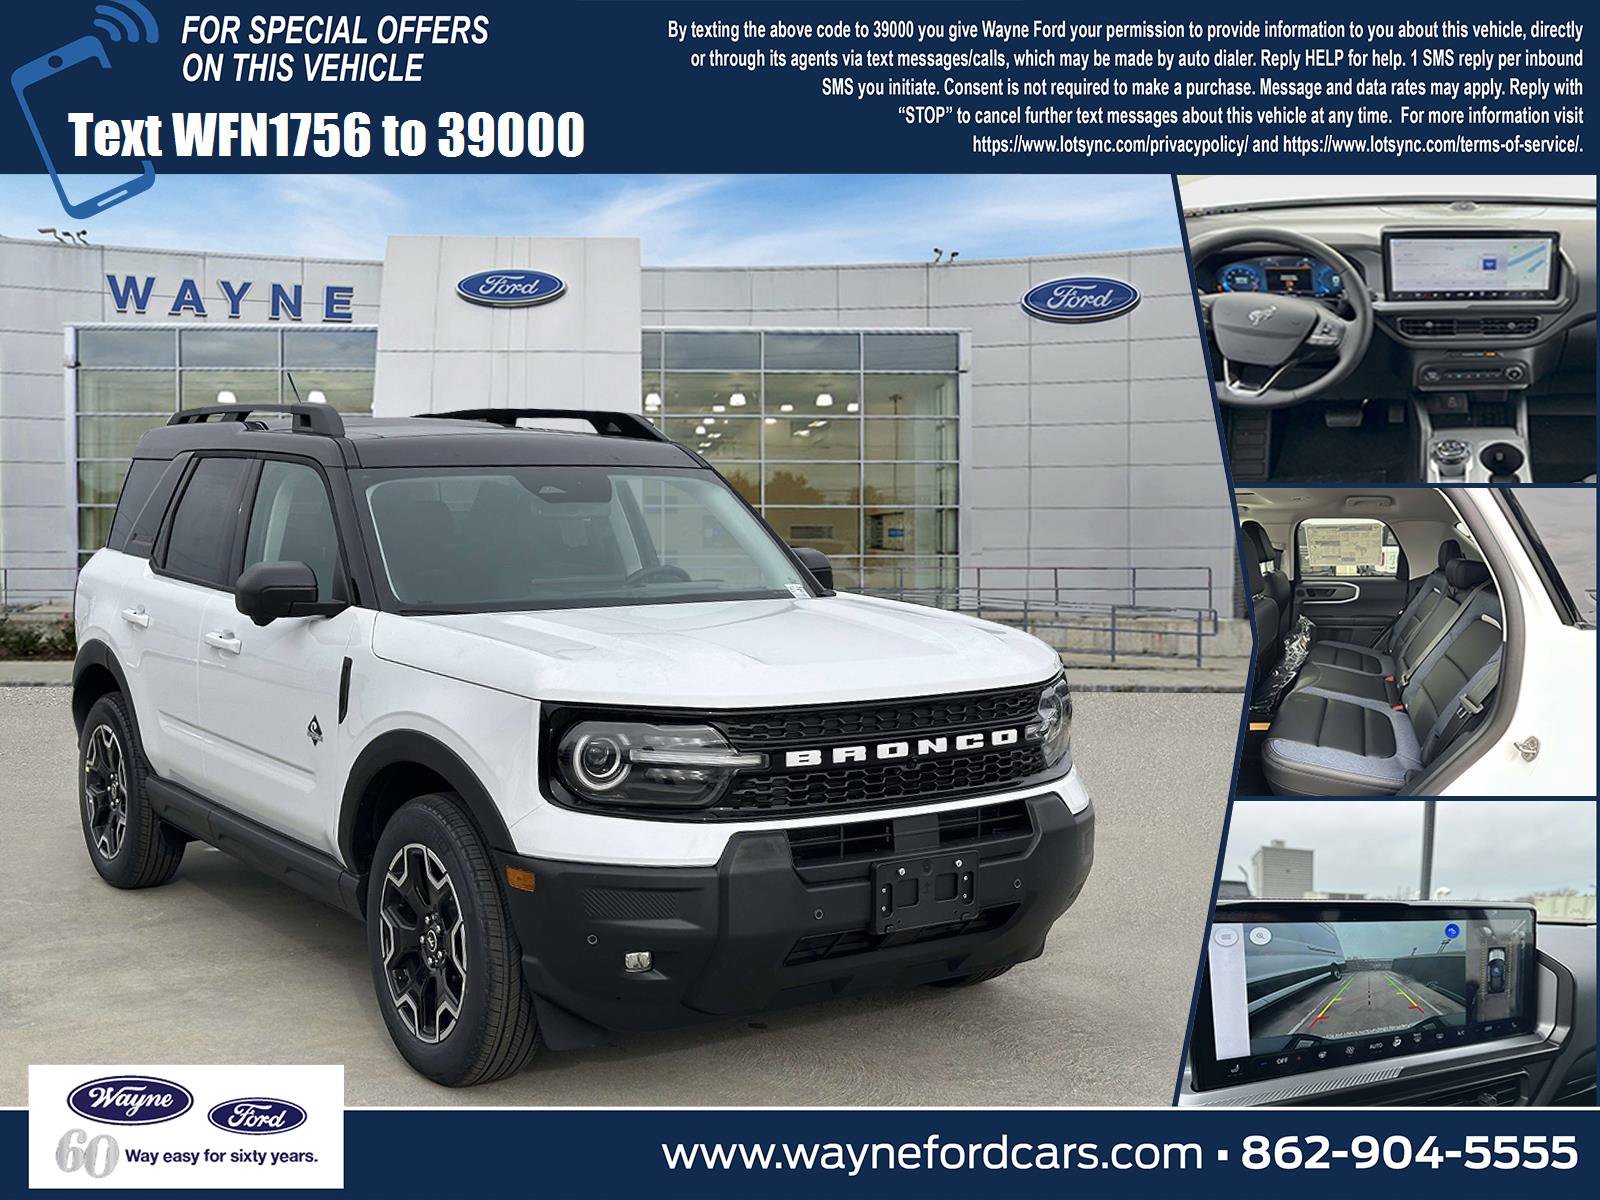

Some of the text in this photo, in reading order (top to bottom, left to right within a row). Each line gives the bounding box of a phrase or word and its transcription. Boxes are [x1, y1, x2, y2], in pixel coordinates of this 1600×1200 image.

[107, 273, 355, 323] WAYNE
[478, 274, 540, 298] Ford
[1047, 285, 1114, 309] Ford
[785, 728, 1019, 768] BRONCO
